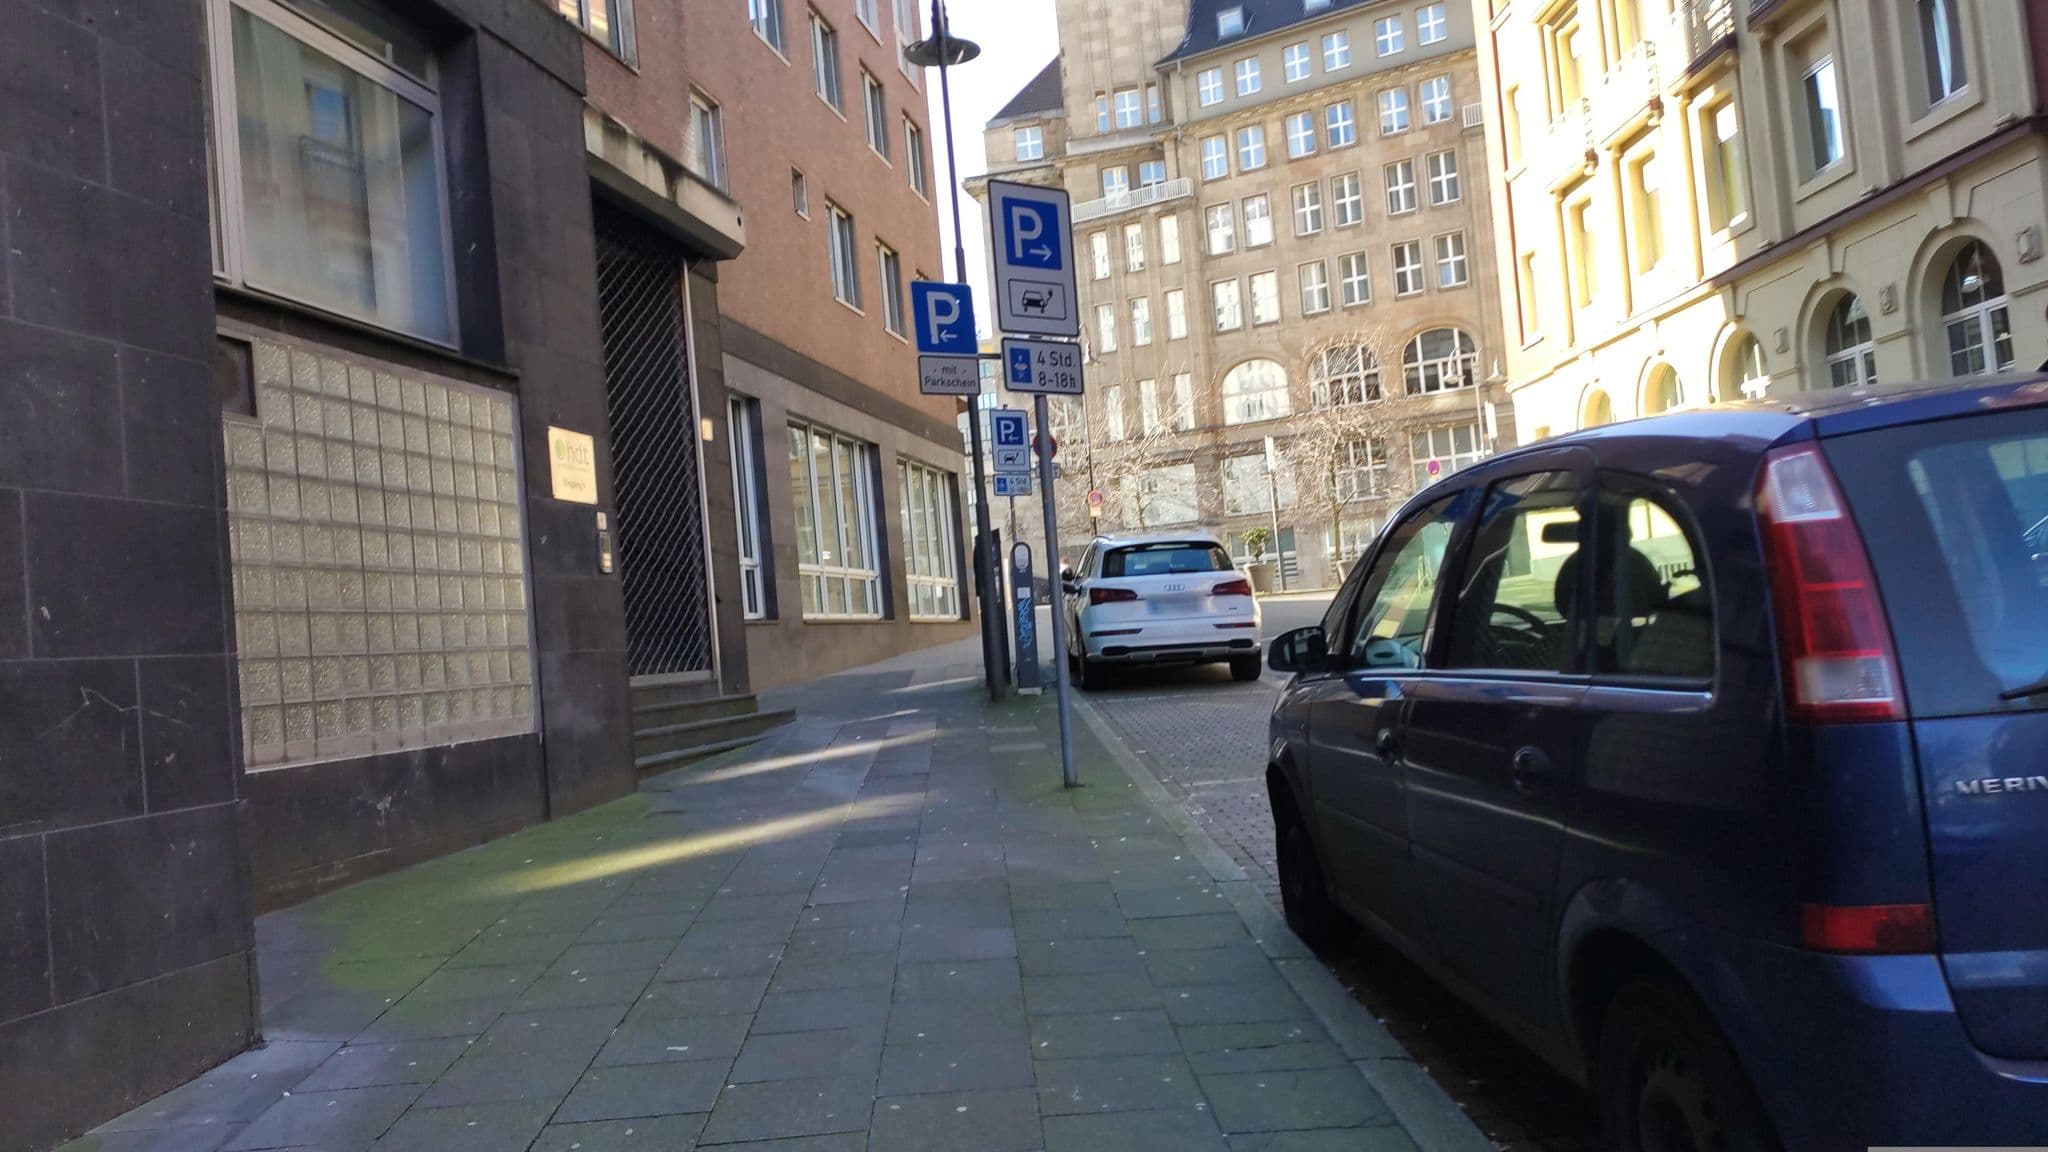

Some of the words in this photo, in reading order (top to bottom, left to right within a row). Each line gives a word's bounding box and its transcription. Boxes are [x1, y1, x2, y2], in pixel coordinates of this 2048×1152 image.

[1011, 205, 1043, 259] P
[926, 290, 961, 345] P
[1037, 350, 1046, 366] 4
[1049, 350, 1076, 368] Std.
[941, 364, 958, 375] mit
[924, 375, 977, 388] Parkschein
[1038, 371, 1076, 388] 8-18h
[999, 420, 1015, 443] P
